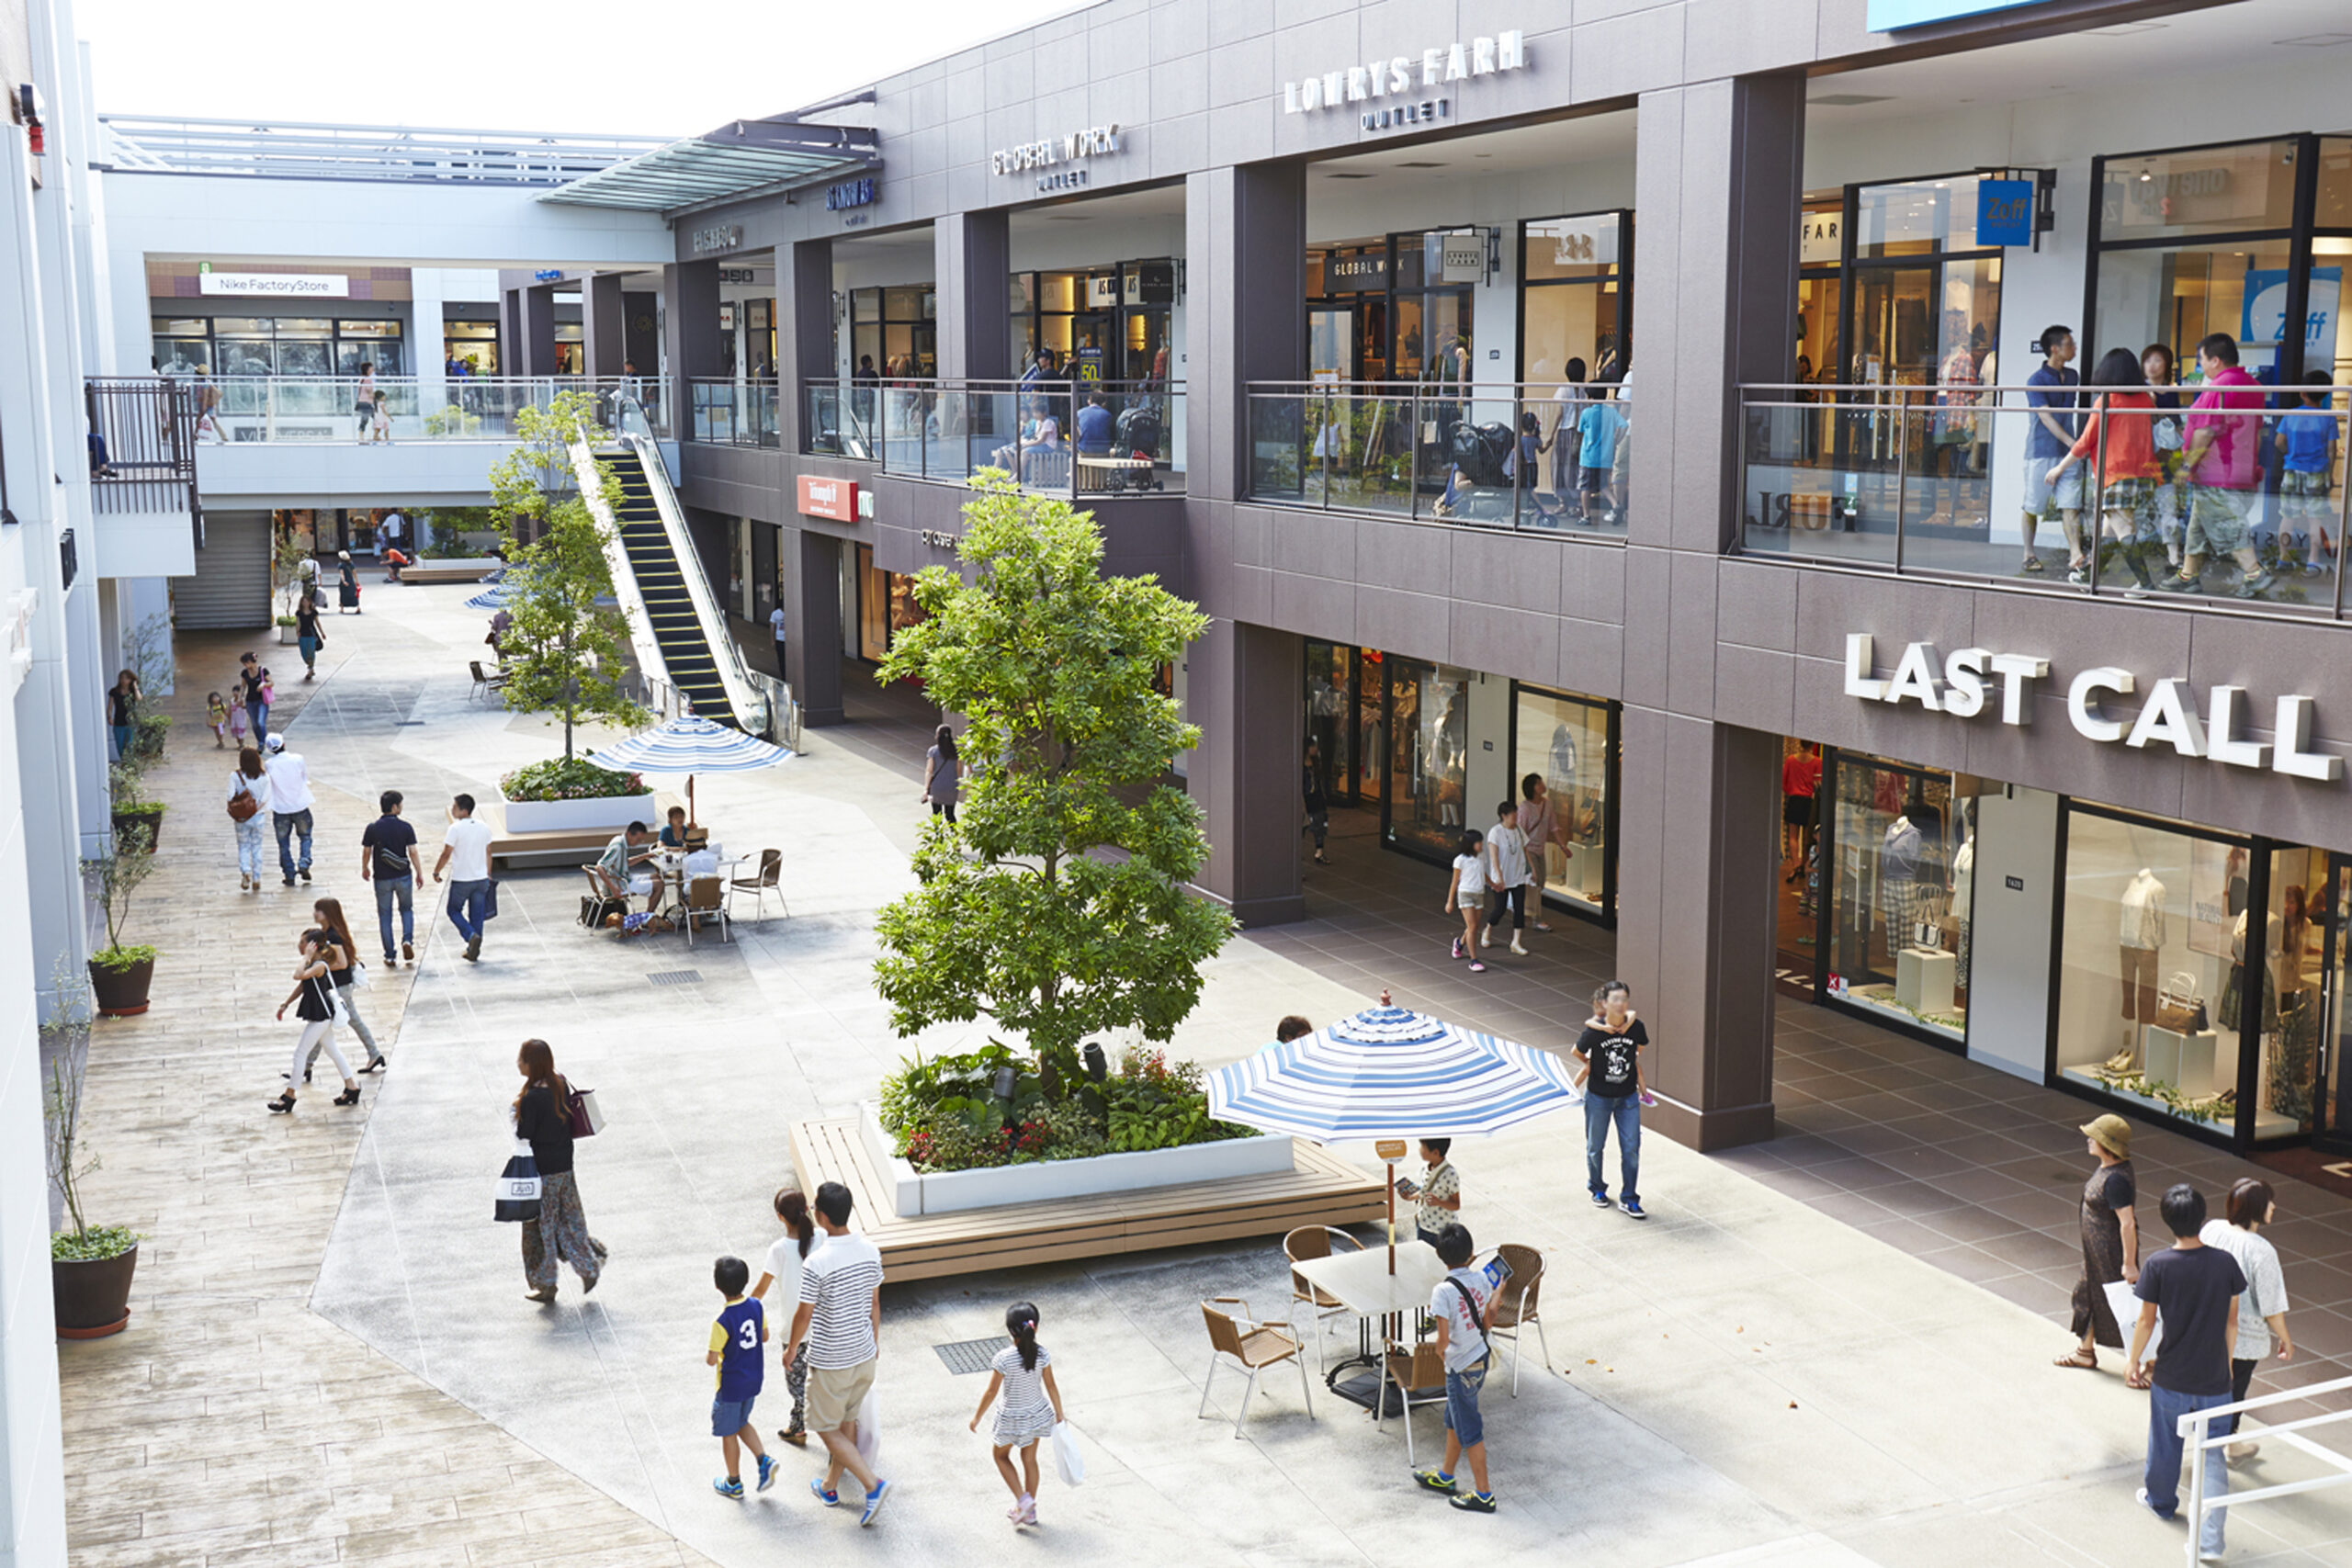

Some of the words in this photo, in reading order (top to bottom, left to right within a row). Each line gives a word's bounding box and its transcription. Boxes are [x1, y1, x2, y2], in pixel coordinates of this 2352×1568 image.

[1284, 56, 1410, 114] LOWRYS
[1422, 28, 1524, 85] FARM
[1360, 97, 1449, 131] OUTLET
[992, 138, 1057, 176] GLOBAL
[1064, 122, 1121, 161] WORK
[1985, 197, 2028, 220] Zoff
[1334, 262, 1373, 276] GLOBAL
[1376, 258, 1405, 273] WK
[220, 278, 248, 290] Nike
[2273, 311, 2327, 341] Zff
[1844, 632, 2050, 727] LAST
[2067, 666, 2346, 782] CALL
[739, 1317, 758, 1350] 3
